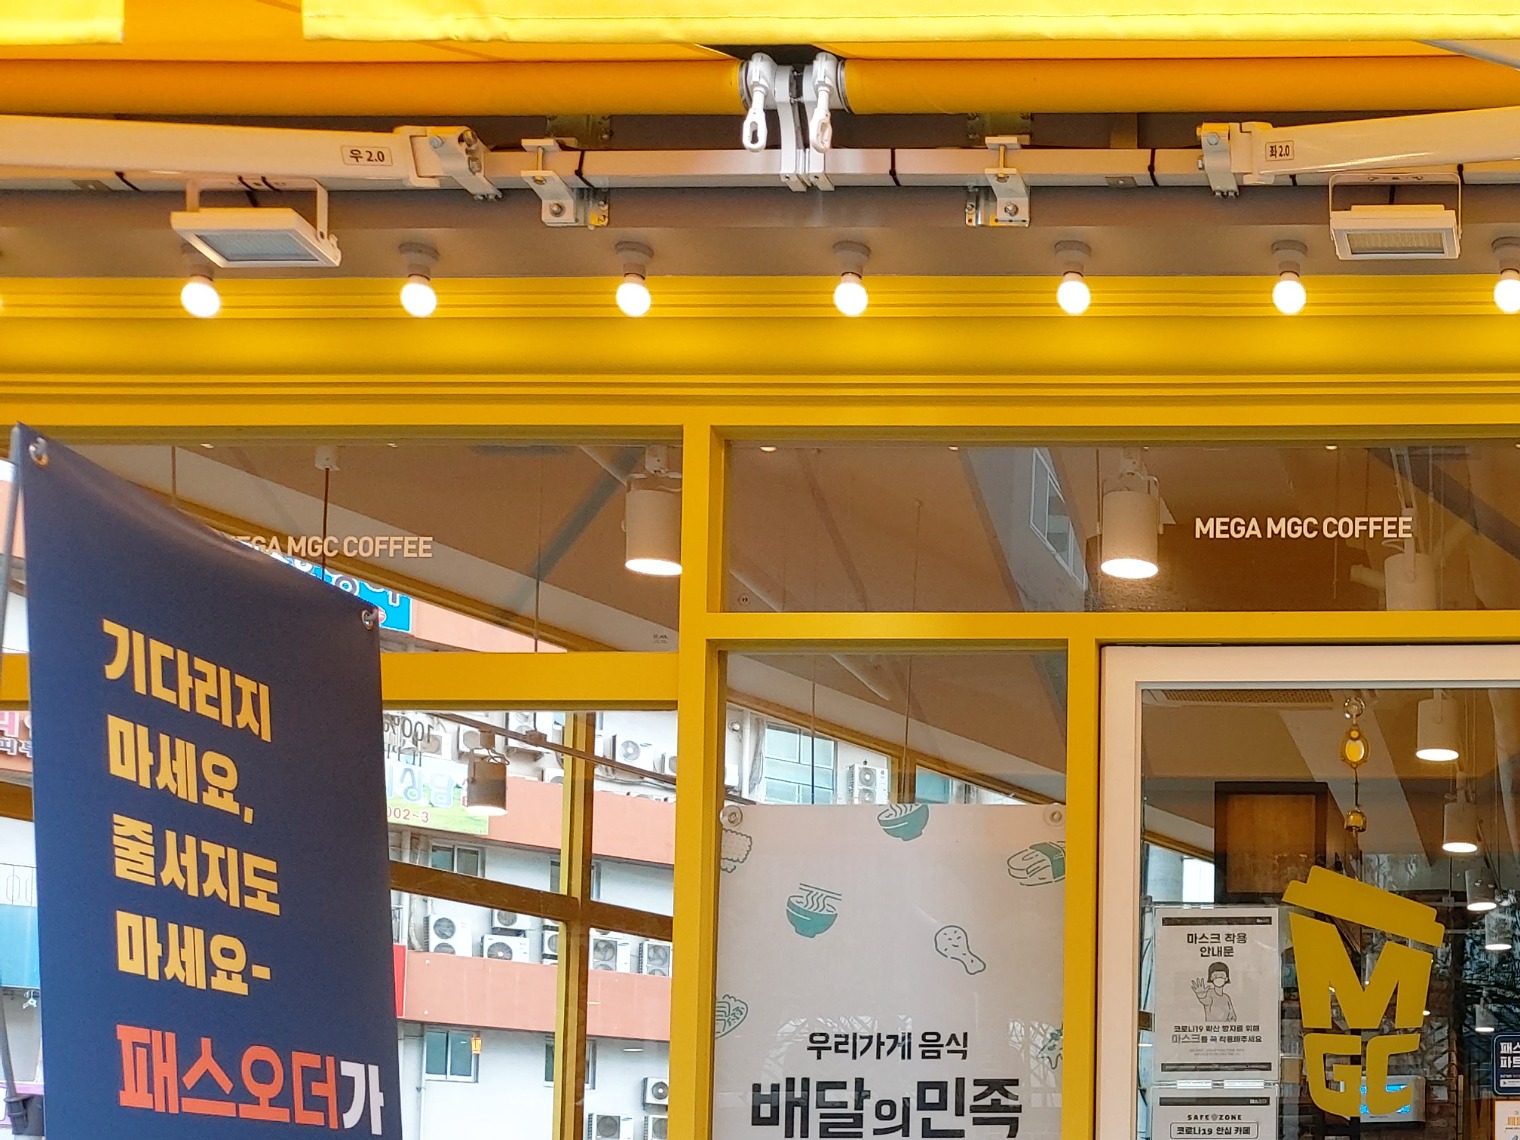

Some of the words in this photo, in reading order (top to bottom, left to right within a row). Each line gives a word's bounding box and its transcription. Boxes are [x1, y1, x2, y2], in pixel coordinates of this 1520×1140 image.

[349, 149, 362, 162] 우
[365, 150, 385, 162] 2.0
[1278, 145, 1290, 157] 2.0
[1195, 517, 1262, 539] MEGA
[1266, 517, 1318, 539] MGC
[1322, 517, 1412, 539] COFFEE
[287, 535, 339, 558] MGC
[343, 536, 433, 558] COFFEE
[103, 618, 272, 743] 기다리지
[107, 714, 254, 825] 마세요,
[112, 813, 281, 916] 줄서지도
[1187, 933, 1221, 945] 마스크
[1224, 932, 1248, 945] 착용
[1200, 946, 1235, 958] 안내문
[806, 1031, 912, 1060] 우리가게
[918, 1031, 969, 1060] 음식
[116, 1023, 385, 1136] 패스오더가
[751, 1077, 1022, 1140] 배달의민족
[1177, 1126, 1213, 1135] 코로나19
